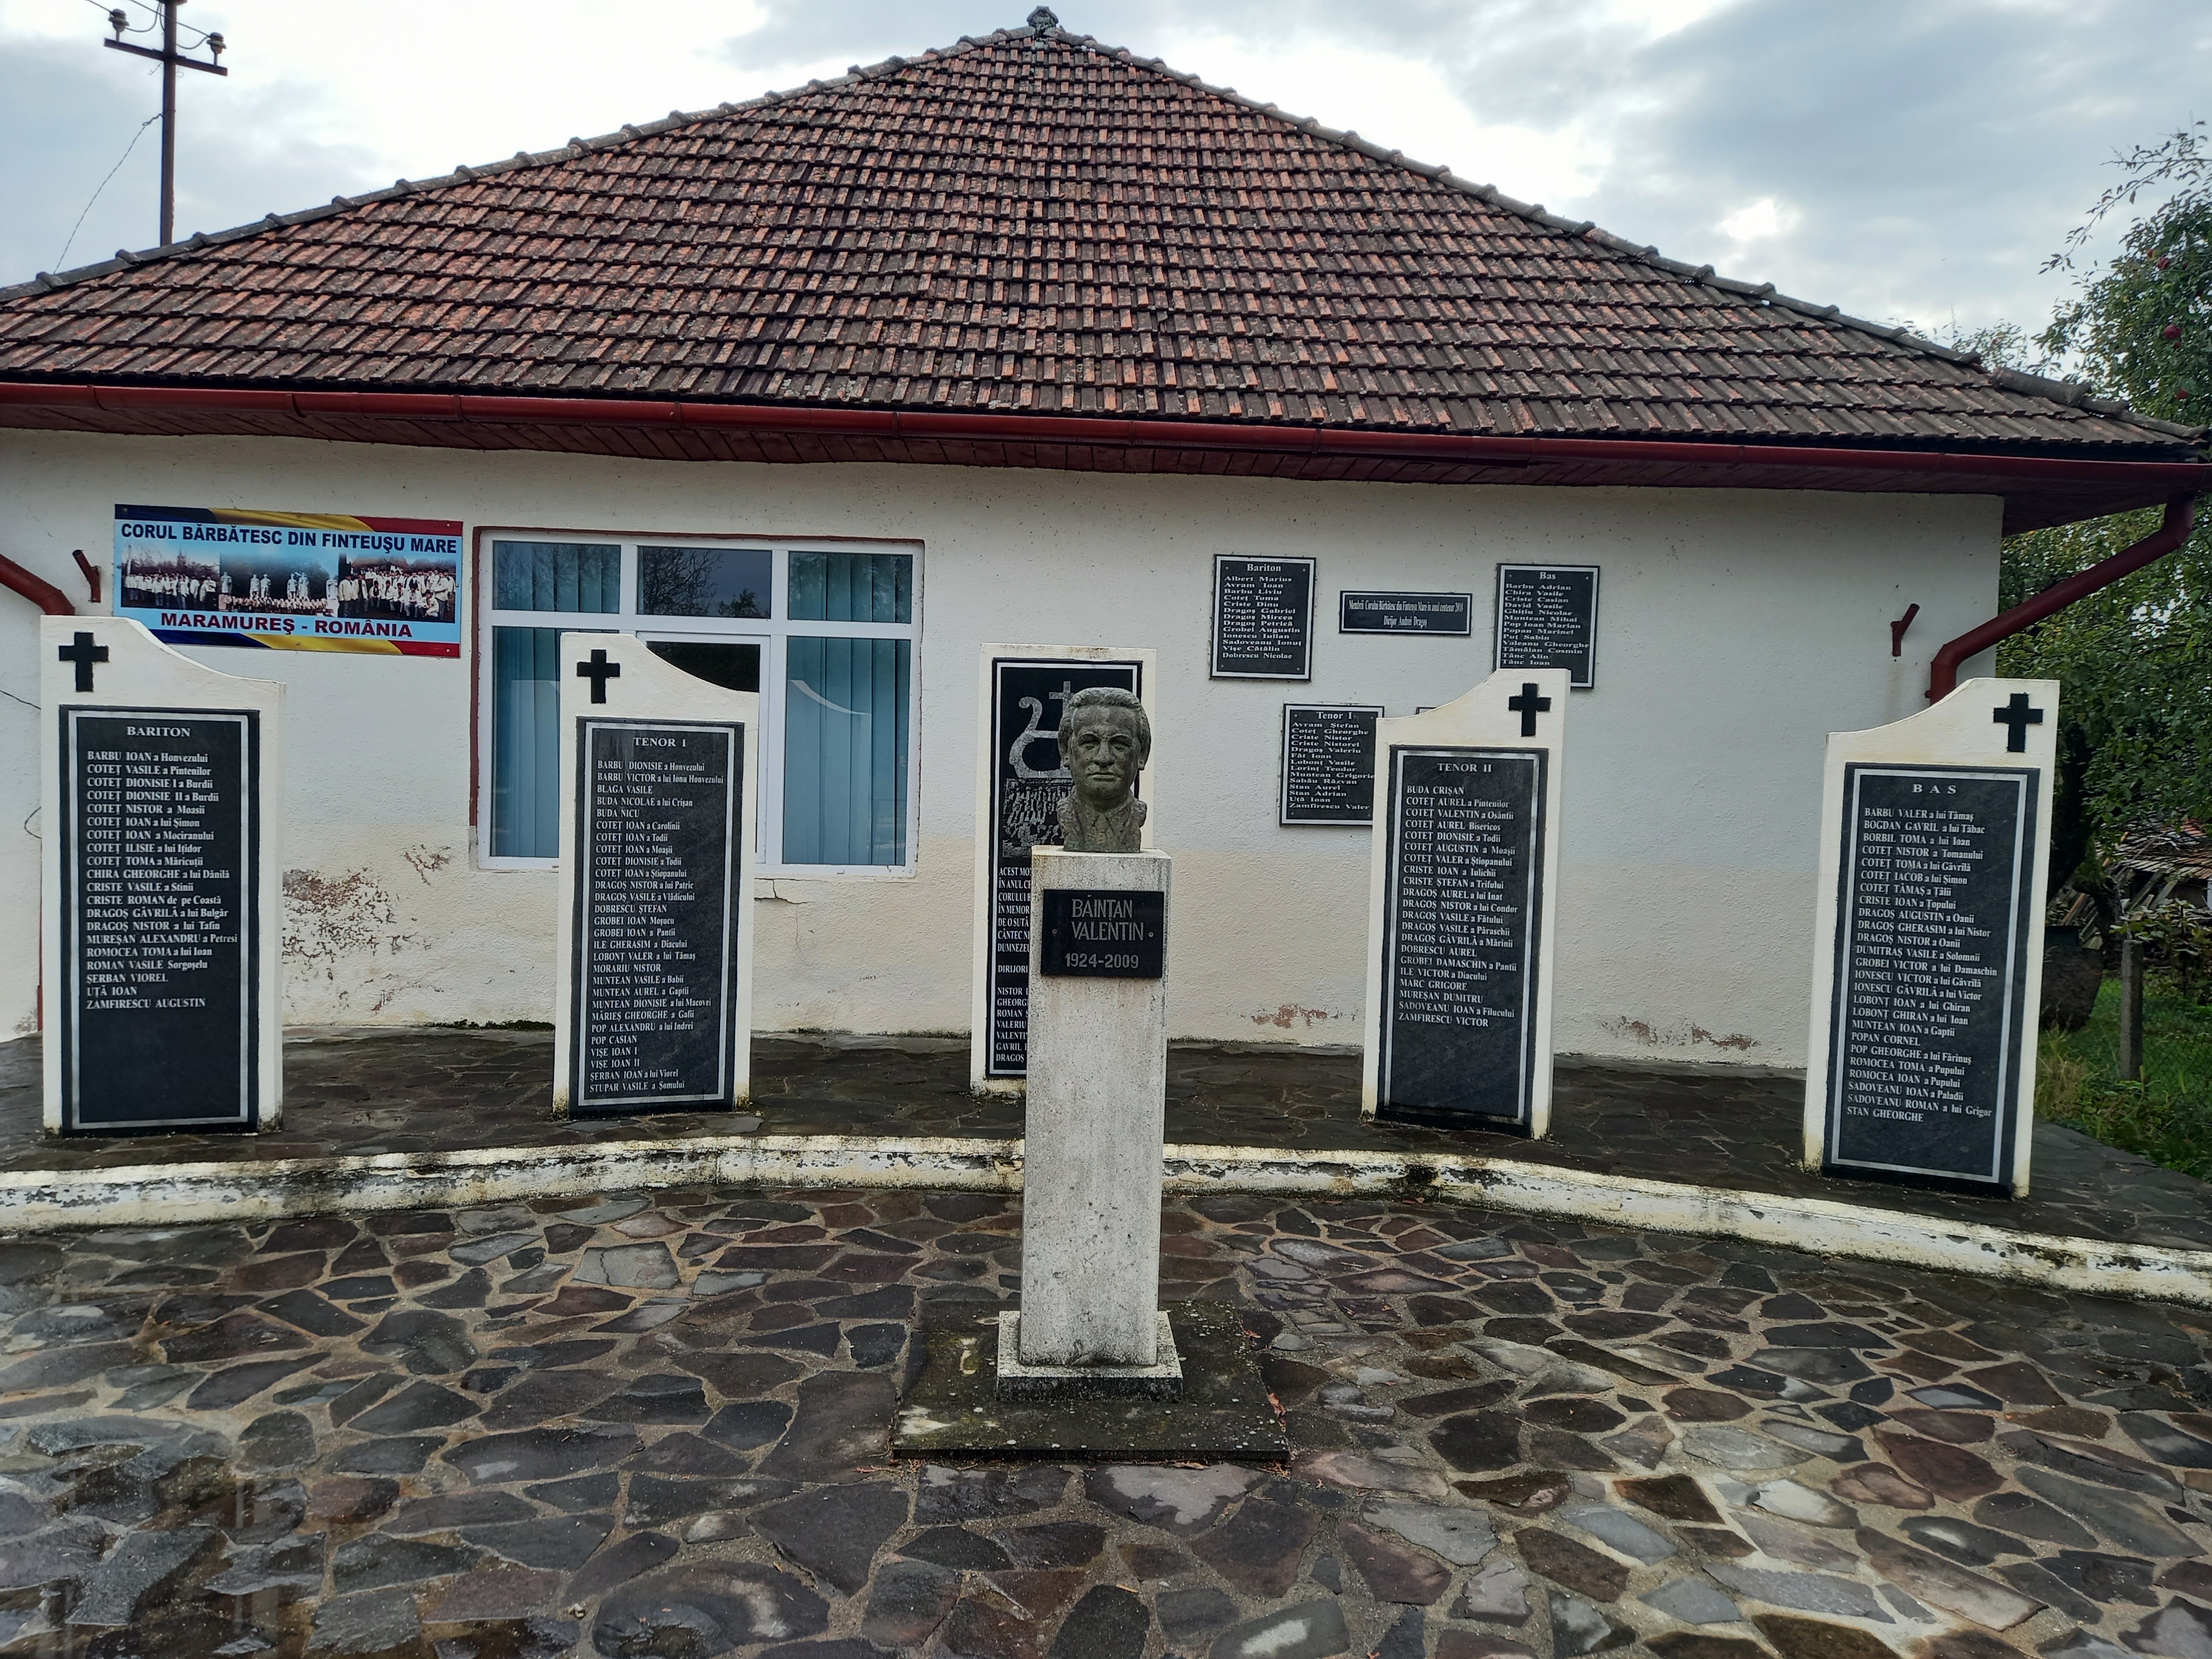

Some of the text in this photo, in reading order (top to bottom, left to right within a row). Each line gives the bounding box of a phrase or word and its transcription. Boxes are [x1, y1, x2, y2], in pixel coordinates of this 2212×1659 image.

[121, 523, 177, 539] CORUL
[182, 523, 282, 544] BĂRBĂTESC
[288, 531, 316, 546] DIN
[410, 538, 457, 554] MARE
[1540, 571, 1556, 580] Bas
[315, 619, 413, 638] ROMÂNIA
[127, 726, 191, 737] BARITON
[633, 737, 686, 747] TENOR I
[87, 750, 121, 760] BARBU
[126, 752, 151, 761] IOAN
[160, 752, 208, 762] Honvezului
[598, 760, 623, 769] BARBU
[629, 761, 662, 770] DIONISIE
[669, 762, 705, 771] Honvezului
[1437, 763, 1492, 773] TENOR II
[597, 784, 653, 794] BLAGA VASILE
[596, 807, 639, 817] BUDA NICU
[1437, 820, 1465, 830] AUREL
[1469, 821, 1500, 831] Bisericos
[1863, 832, 1896, 842] BORBIL
[1899, 834, 1927, 844] TOMA
[1938, 836, 1949, 844] lui
[1953, 836, 1970, 846] Ioan
[1896, 846, 1929, 857] NISTOR
[1941, 848, 1983, 859] Tomanului
[87, 869, 119, 878] CHIRA
[123, 869, 180, 879] GHEORGHE
[190, 869, 200, 878] lui
[999, 867, 1019, 876] ACEST
[1404, 865, 1433, 874] CRISTE
[1437, 866, 1458, 875] IOAN
[1470, 868, 1496, 877] Iulichii
[1006, 880, 1023, 889] ANUL
[87, 895, 123, 904] CRISTE
[127, 895, 164, 904] ROMAN
[166, 895, 177, 904] de
[181, 898, 191, 906] pe
[998, 893, 1026, 901] CORULUI
[998, 918, 1006, 927] DE
[1008, 917, 1013, 927] O
[1071, 921, 1144, 941] VALENTIN
[609, 940, 650, 948] GHERASIM
[661, 940, 687, 948] Diacului
[1401, 944, 1477, 957] DOBRESCU AUREL
[1065, 953, 1139, 968] 1924-2009
[593, 963, 661, 973] MORARIU NISTOR
[1400, 967, 1413, 975] ILE
[1417, 968, 1449, 978] VICTOR
[1457, 971, 1486, 980] Diacului
[131, 973, 168, 982] VIOREL
[1400, 978, 1467, 990] MARC GRIGORE
[86, 998, 205, 1009] ZAMFIRESCU AUGUSTIN
[997, 1009, 1022, 1018] ROMAN
[997, 1020, 1026, 1029] VALERIU
[1399, 1013, 1488, 1026] ZAMFIRESCU VICTOR
[1852, 1019, 1896, 1031] MUNTEAN
[1900, 1023, 1922, 1033] IOAN
[1930, 1026, 1955, 1037] Gaptii
[591, 1035, 637, 1045] POP CASIAN
[1851, 1031, 1921, 1046] POPAN CORNEL
[612, 1059, 630, 1067] IOAN
[1850, 1056, 1895, 1068] ROMOCEA
[1898, 1061, 1925, 1071] TOMA
[1934, 1065, 1964, 1076] Pupului
